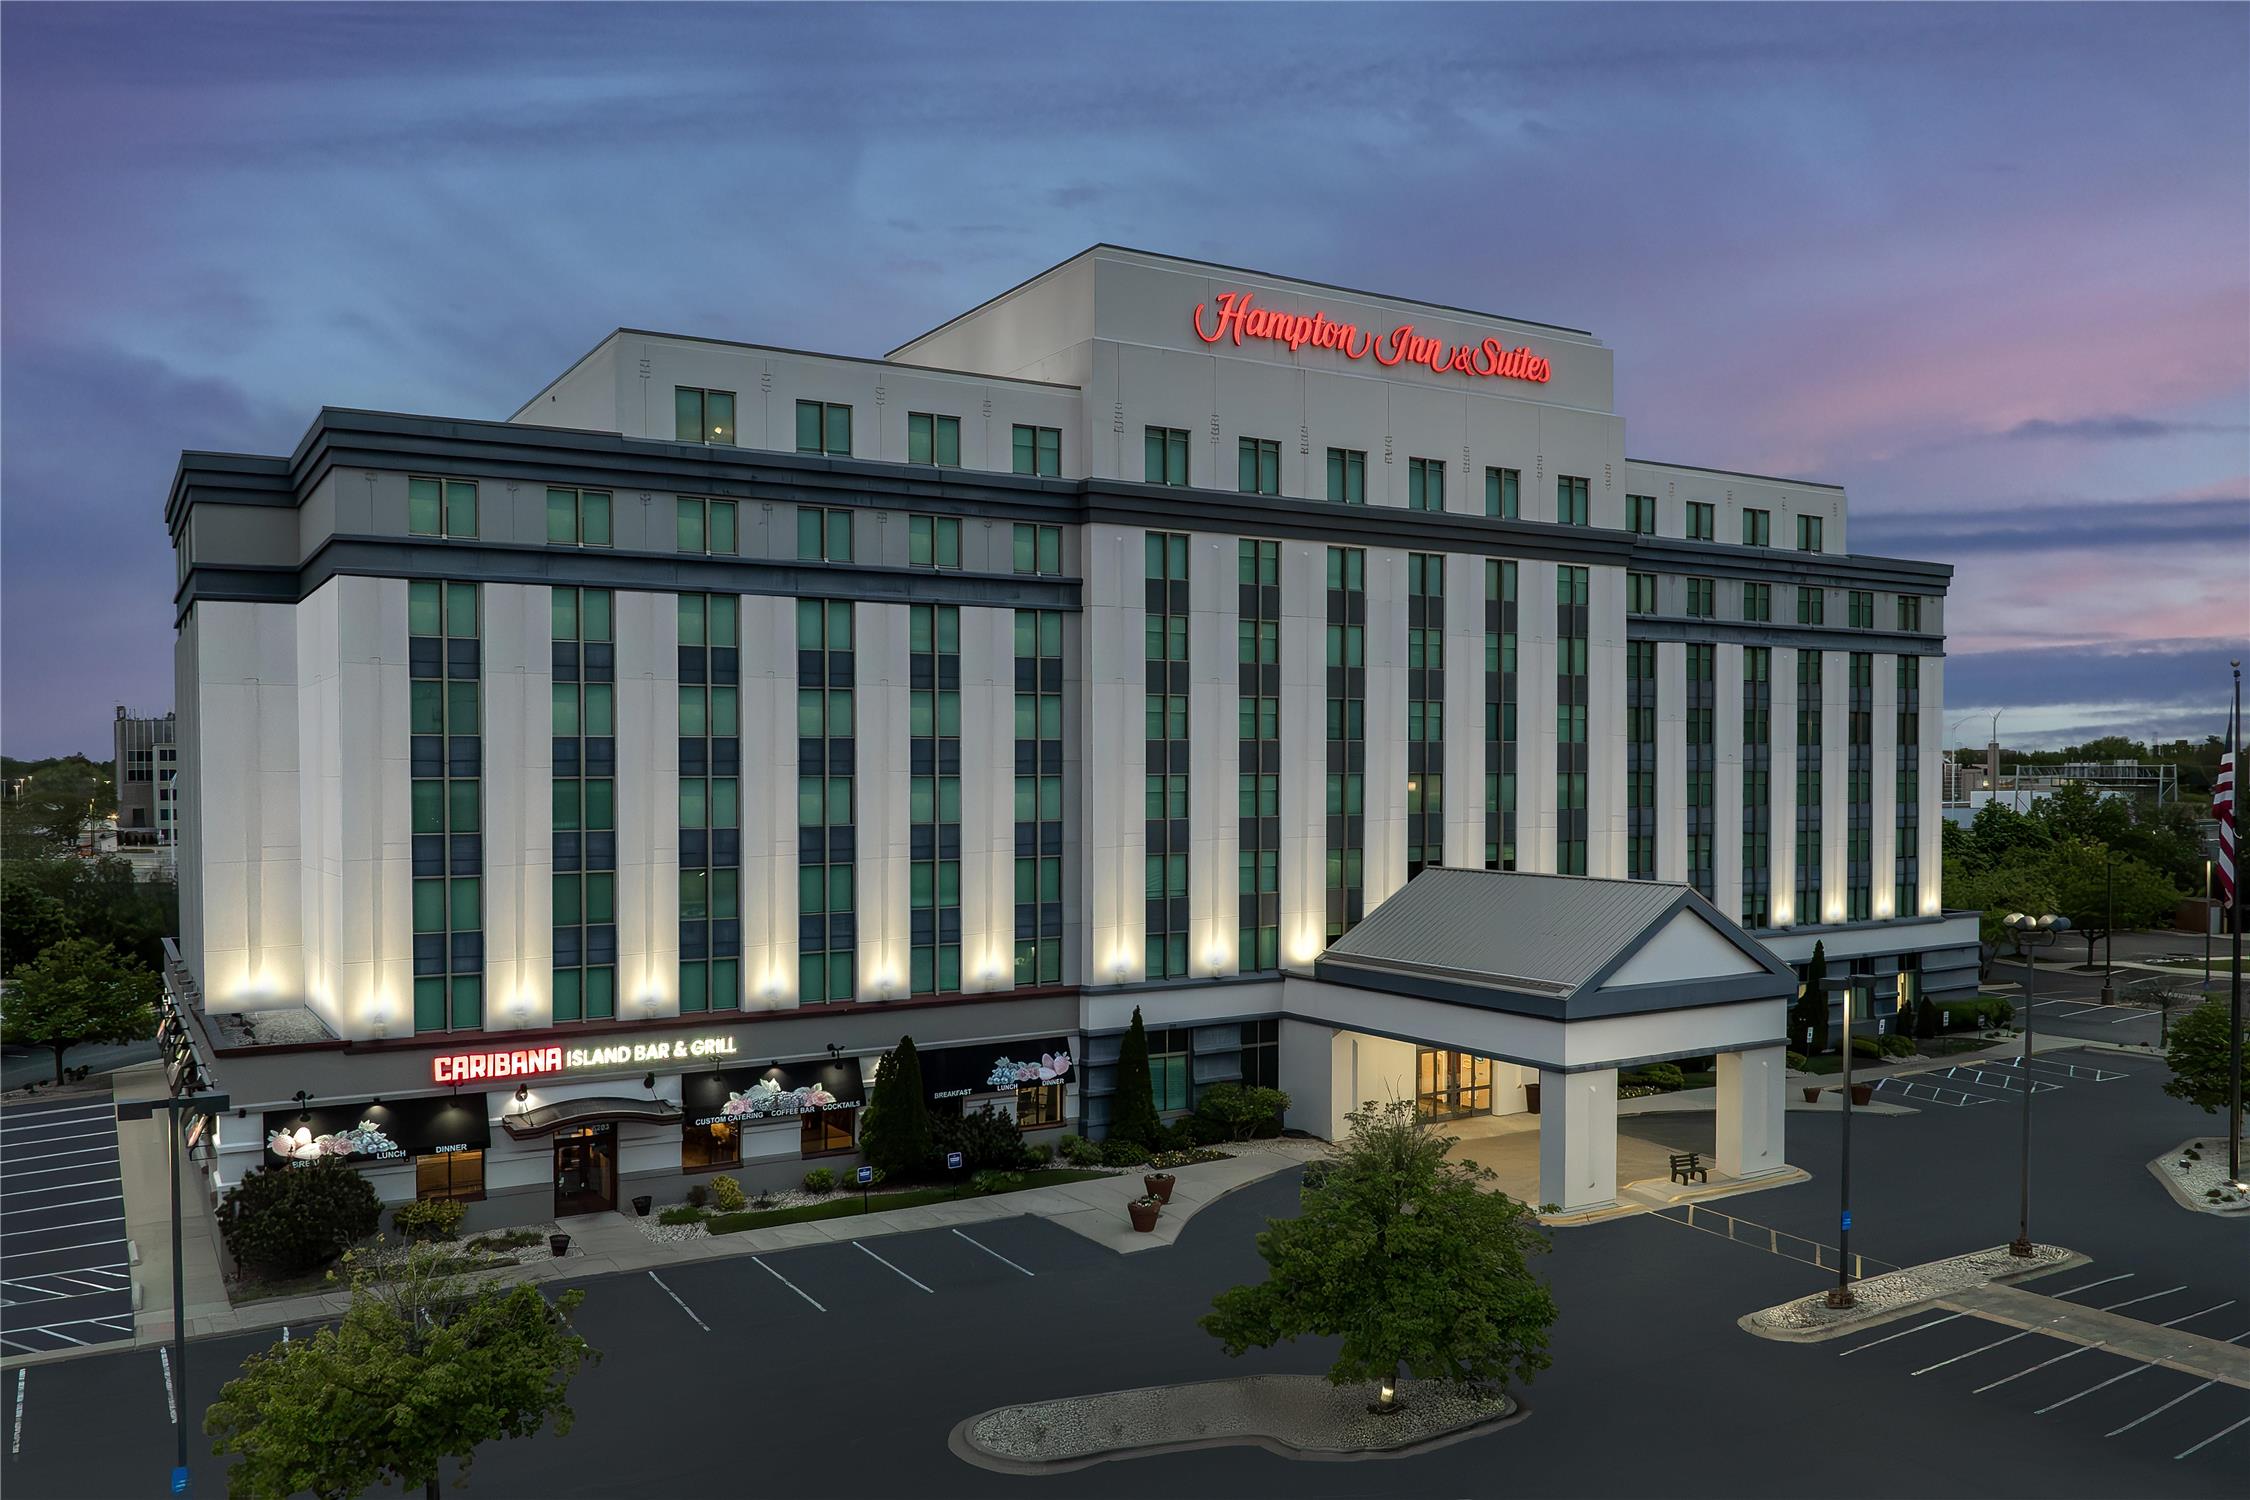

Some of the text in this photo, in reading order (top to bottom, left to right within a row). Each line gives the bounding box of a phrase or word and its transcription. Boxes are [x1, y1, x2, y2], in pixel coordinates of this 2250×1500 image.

[1194, 291, 1552, 383] Hampton Inn & Suites
[566, 1036, 737, 1067] ISLAND BAR & GRILL
[434, 1047, 562, 1081] CARIBANA
[997, 1083, 1018, 1092] LUNCH
[934, 1089, 972, 1099] BREAKFAST
[771, 1106, 815, 1117] COFFEE BAR
[822, 1101, 861, 1111] COCKTAILS
[695, 1111, 764, 1126] CUSTOM CATERING
[435, 1143, 468, 1154] DINNER
[376, 1150, 407, 1160] LUNCH
